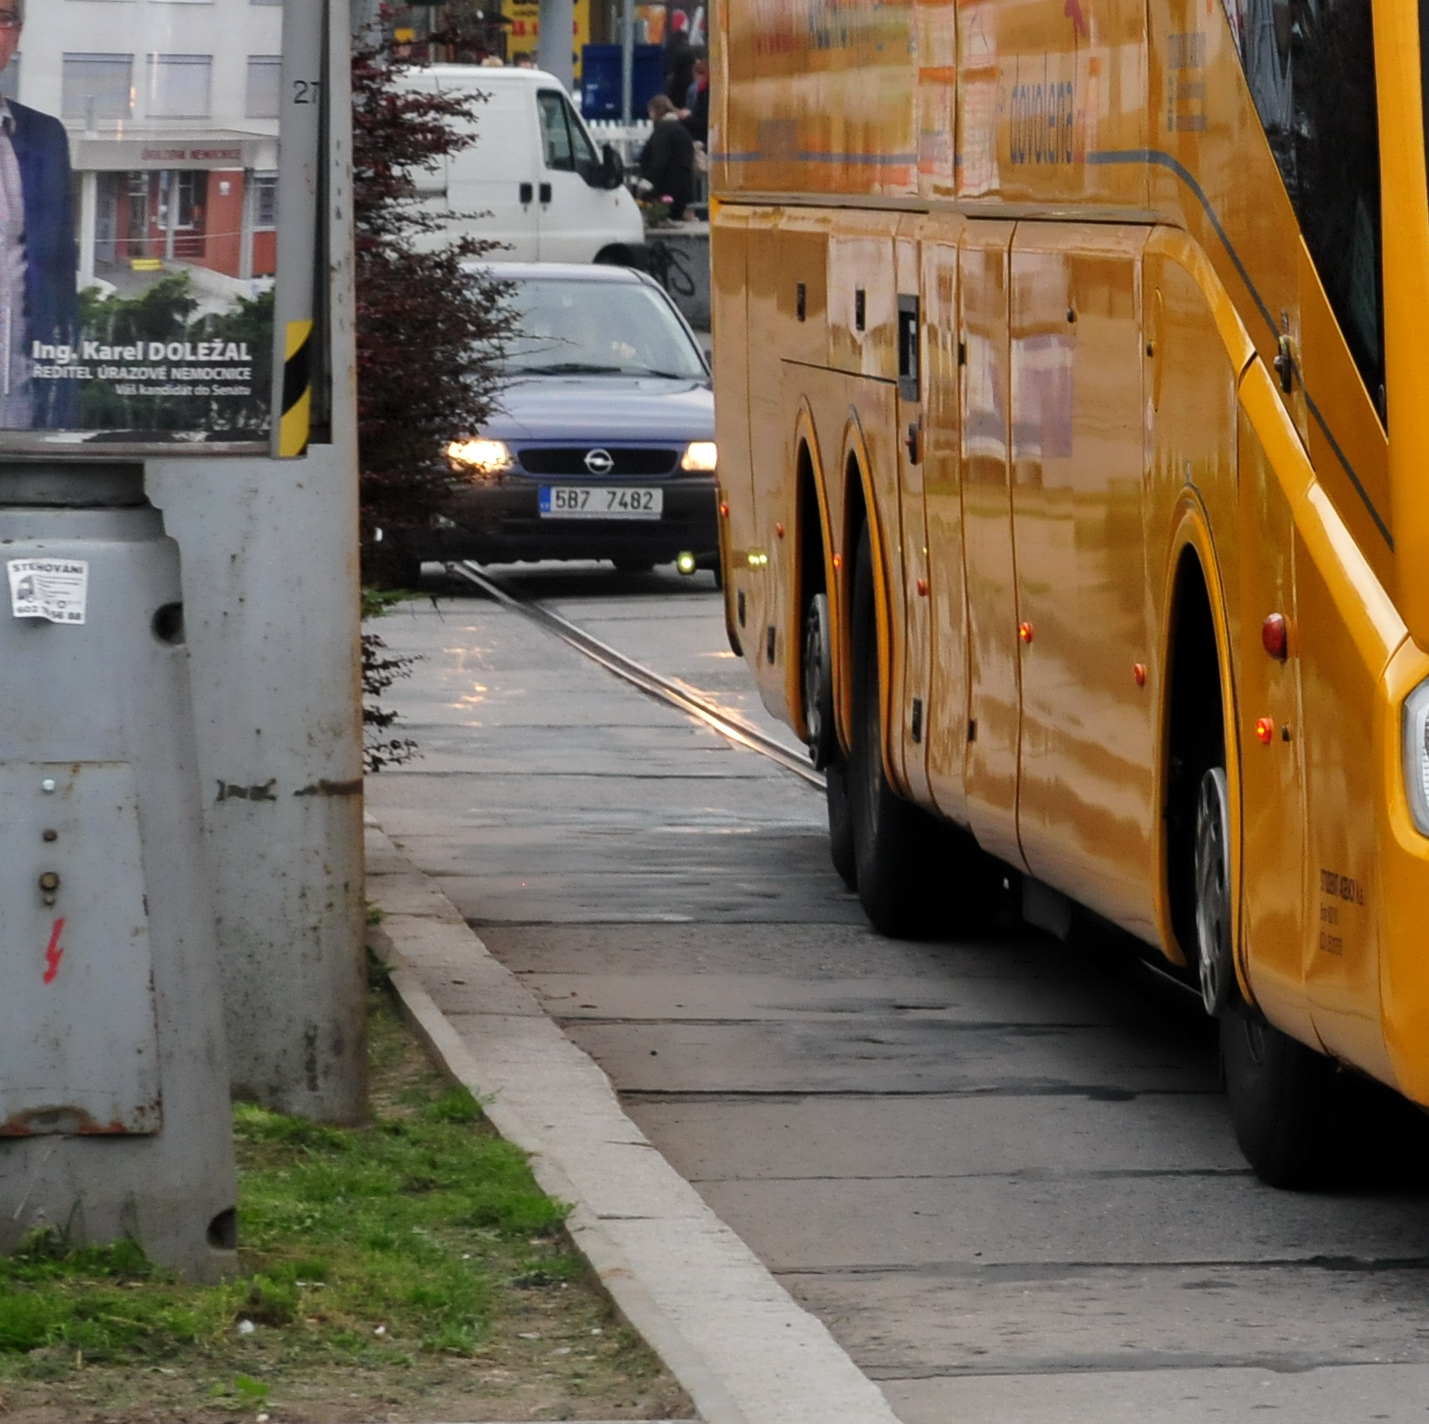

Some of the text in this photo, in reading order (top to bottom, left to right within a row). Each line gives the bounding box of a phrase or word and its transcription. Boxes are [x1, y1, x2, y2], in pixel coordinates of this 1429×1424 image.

[33, 338, 252, 364] Ing. Karel DOLEŽAL
[170, 367, 252, 380] NEMOCNICE
[555, 490, 653, 511] 5B7 7482
